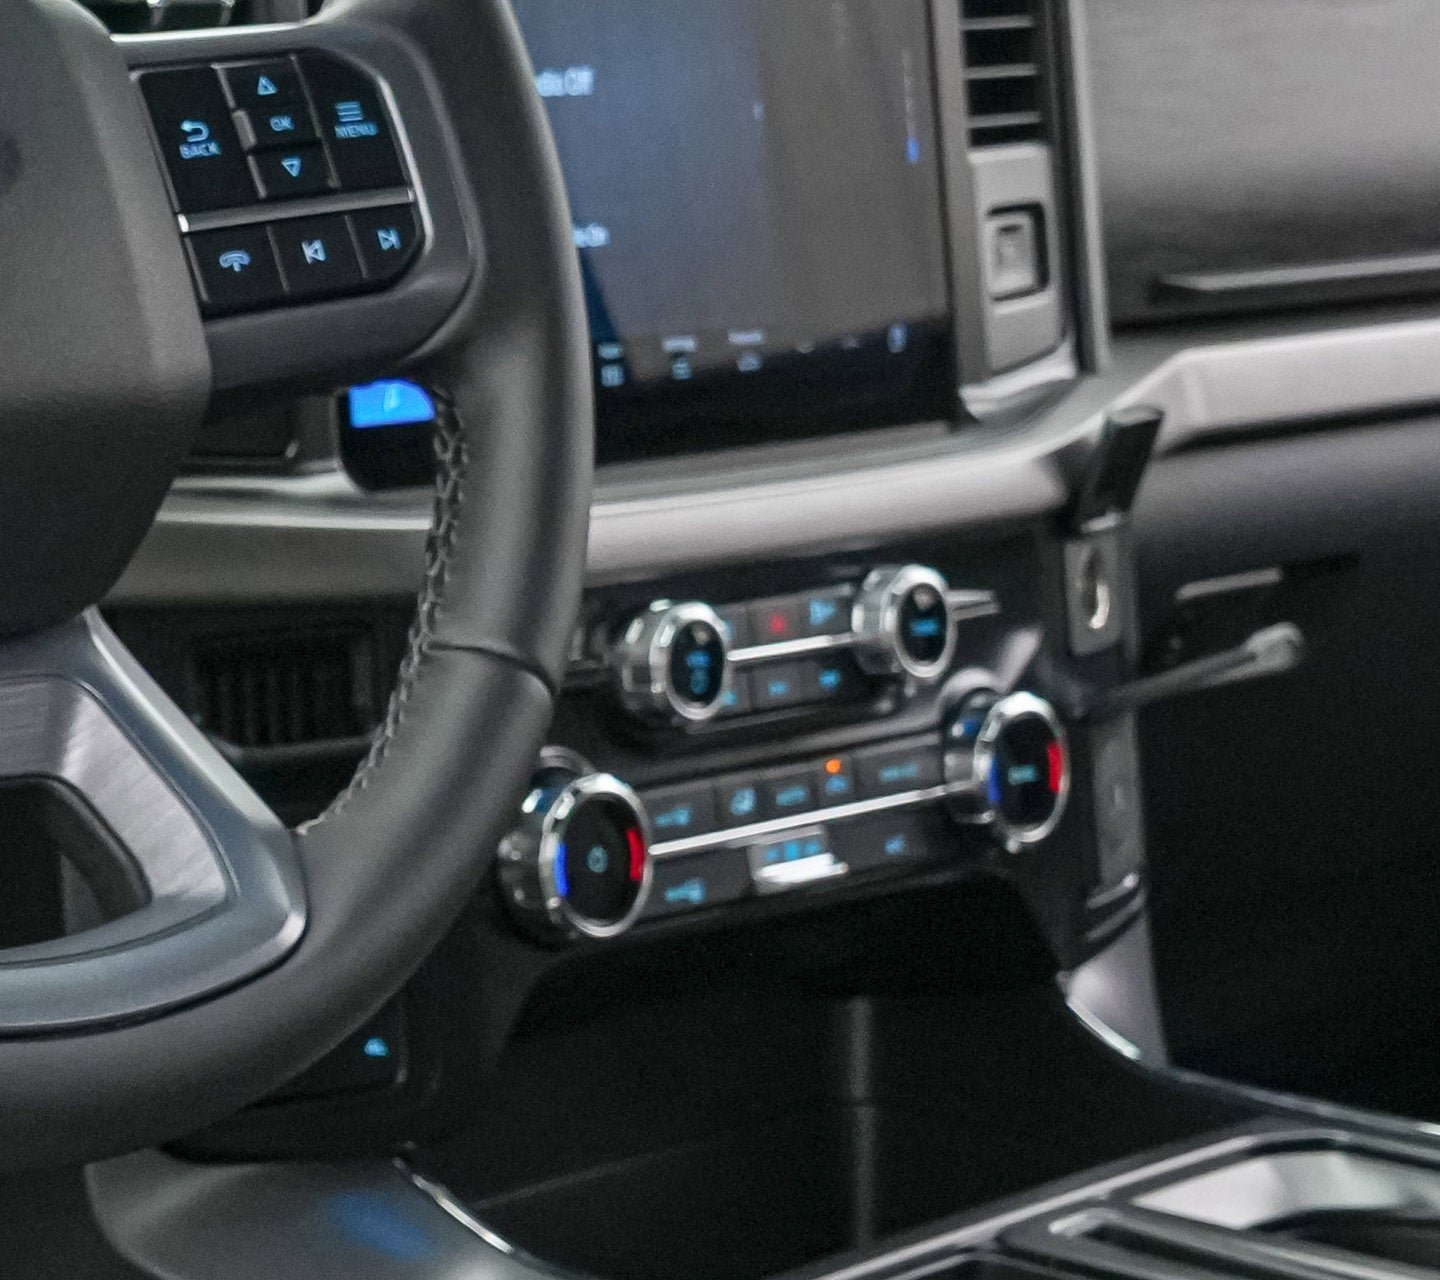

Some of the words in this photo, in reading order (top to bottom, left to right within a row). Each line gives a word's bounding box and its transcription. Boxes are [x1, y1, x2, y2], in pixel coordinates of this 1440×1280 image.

[269, 115, 296, 132] OK
[333, 119, 380, 140] MENU
[178, 139, 222, 160] BACK
